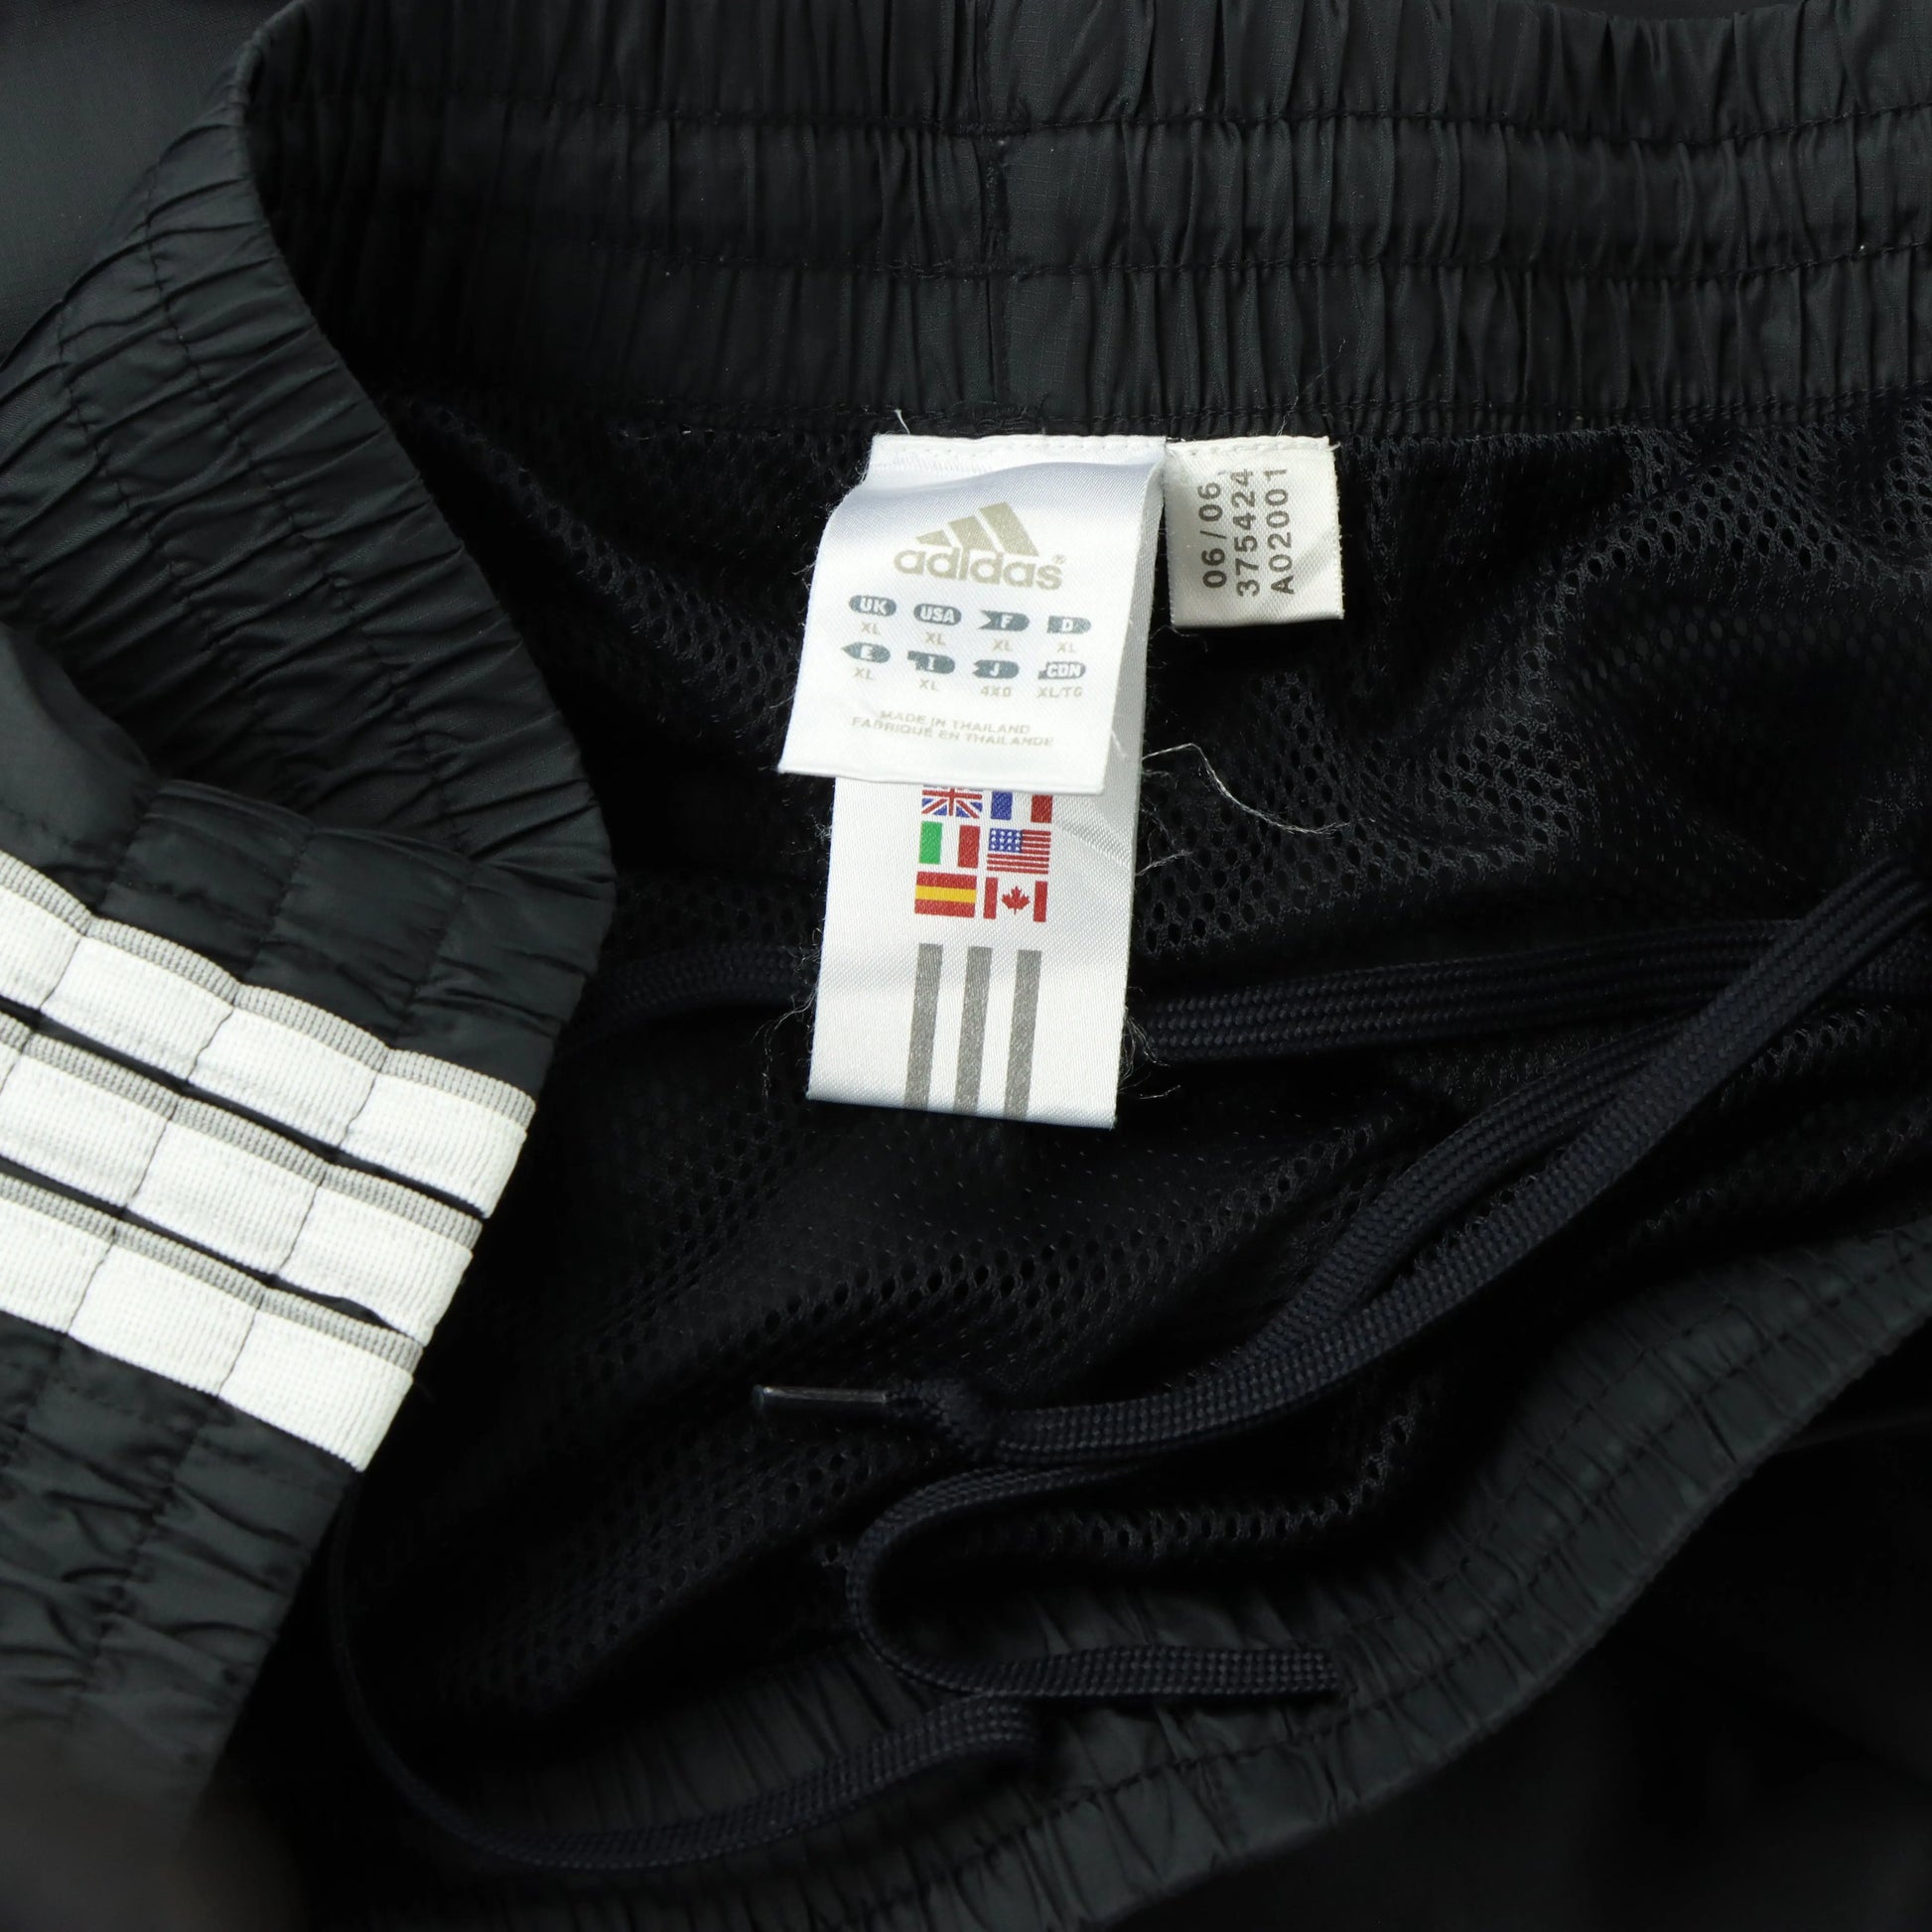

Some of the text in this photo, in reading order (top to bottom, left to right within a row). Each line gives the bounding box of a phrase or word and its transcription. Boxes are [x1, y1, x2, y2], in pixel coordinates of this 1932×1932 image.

[1197, 483, 1227, 588] 06/06
[1230, 469, 1260, 597] 375424
[1263, 469, 1295, 595] A02001
[860, 597, 1074, 631] UK USA F D
[861, 621, 1076, 653] XL XL XL XL
[860, 645, 874, 660] E
[989, 662, 1001, 677] J
[1046, 663, 1082, 677] CDN
[854, 667, 875, 680] XL
[919, 679, 939, 691] XL
[851, 716, 1055, 747] FABRIQUE EN THAILANDE
[880, 709, 1032, 736] MADE IN THAILAND
